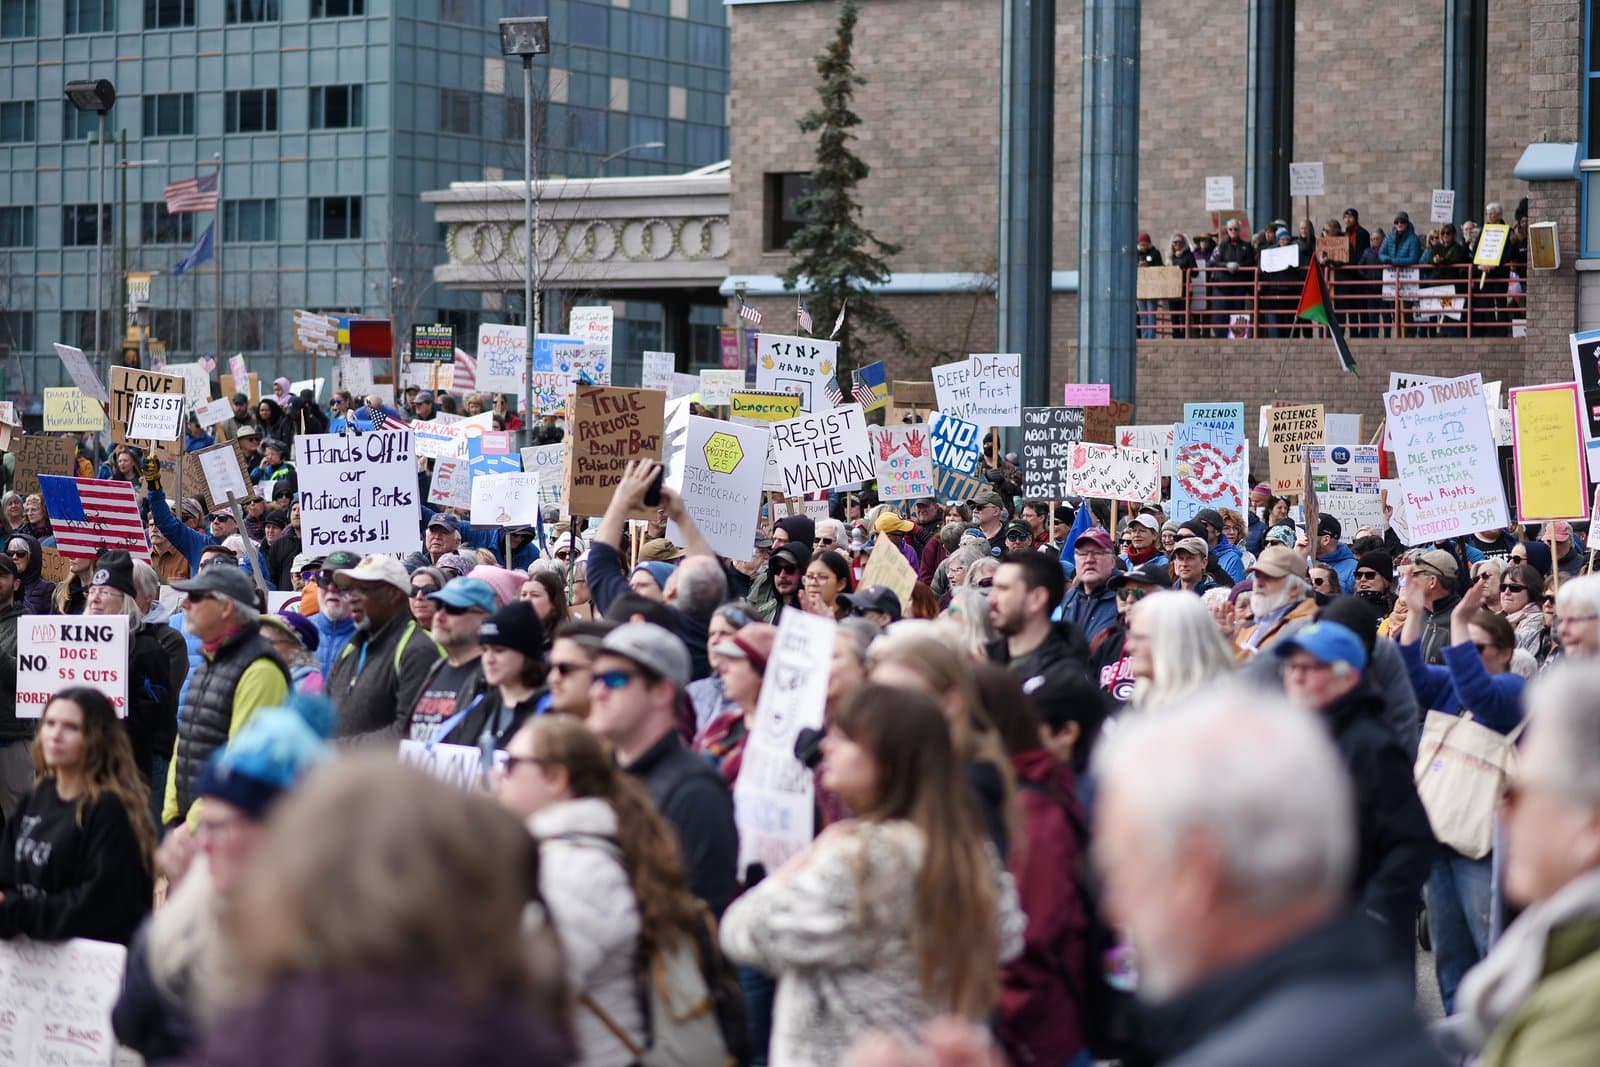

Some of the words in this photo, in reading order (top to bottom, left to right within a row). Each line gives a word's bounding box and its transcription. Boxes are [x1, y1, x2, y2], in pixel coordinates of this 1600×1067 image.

[771, 342, 819, 359] TINY
[778, 362, 815, 376] HANDS
[973, 355, 1019, 379] Defend
[124, 372, 172, 394] LOVE
[522, 373, 571, 388] POTECT
[979, 381, 1012, 400] First
[1389, 389, 1425, 417] GOOD
[1428, 378, 1481, 405] TROUBLE
[63, 398, 86, 414] ARE
[136, 397, 181, 411] RESIST
[581, 388, 645, 416] TRUE
[733, 398, 799, 418] Democracy
[971, 401, 1019, 415] Amendment
[1192, 408, 1238, 419] FRIENDS
[1273, 408, 1317, 421] SCIENCE
[1414, 406, 1468, 425] Amendment
[579, 413, 639, 441] PATRIOTS
[774, 409, 854, 451] RESIST
[938, 416, 977, 447] NO
[1024, 427, 1056, 441] ABOUT
[1059, 425, 1083, 441] YOUR
[1272, 419, 1318, 432] MATTERS
[1176, 423, 1200, 442] WE
[1205, 428, 1234, 446] THE
[1273, 430, 1323, 443] RESEARCH
[24, 439, 64, 451] FREE
[304, 434, 363, 465] Hands
[366, 431, 409, 464] Off!!
[714, 437, 736, 448] STOP
[794, 435, 844, 462] THE
[1023, 445, 1047, 457] OWN
[1050, 443, 1068, 456] RIG
[18, 451, 68, 465] SPEECH
[1088, 446, 1107, 459] Dan
[1284, 454, 1302, 464] LIV
[1407, 451, 1426, 465] DUE
[712, 457, 728, 470] 25
[890, 458, 910, 468] OFF
[1026, 459, 1037, 469] IS
[339, 469, 367, 482] our
[574, 475, 594, 486] WITH
[783, 451, 876, 495] MADMAN
[887, 470, 926, 481] SOCIAL
[1025, 471, 1053, 482] HOW
[1072, 463, 1096, 486] Stand
[884, 483, 934, 495] SECURITY
[1025, 483, 1056, 498] LOSE
[1278, 479, 1291, 489] NO
[372, 486, 412, 507] Parks
[690, 482, 749, 504] DEMOCRACY
[1407, 490, 1434, 510] Equal
[1439, 484, 1475, 500] Rights
[342, 508, 361, 523] and
[1471, 508, 1496, 526] SSA
[310, 519, 389, 545] Forests!!
[60, 624, 114, 642] KING
[59, 647, 97, 660] DOGE
[19, 654, 47, 672] NO
[58, 668, 75, 680] SS
[83, 669, 118, 681] CUTS
